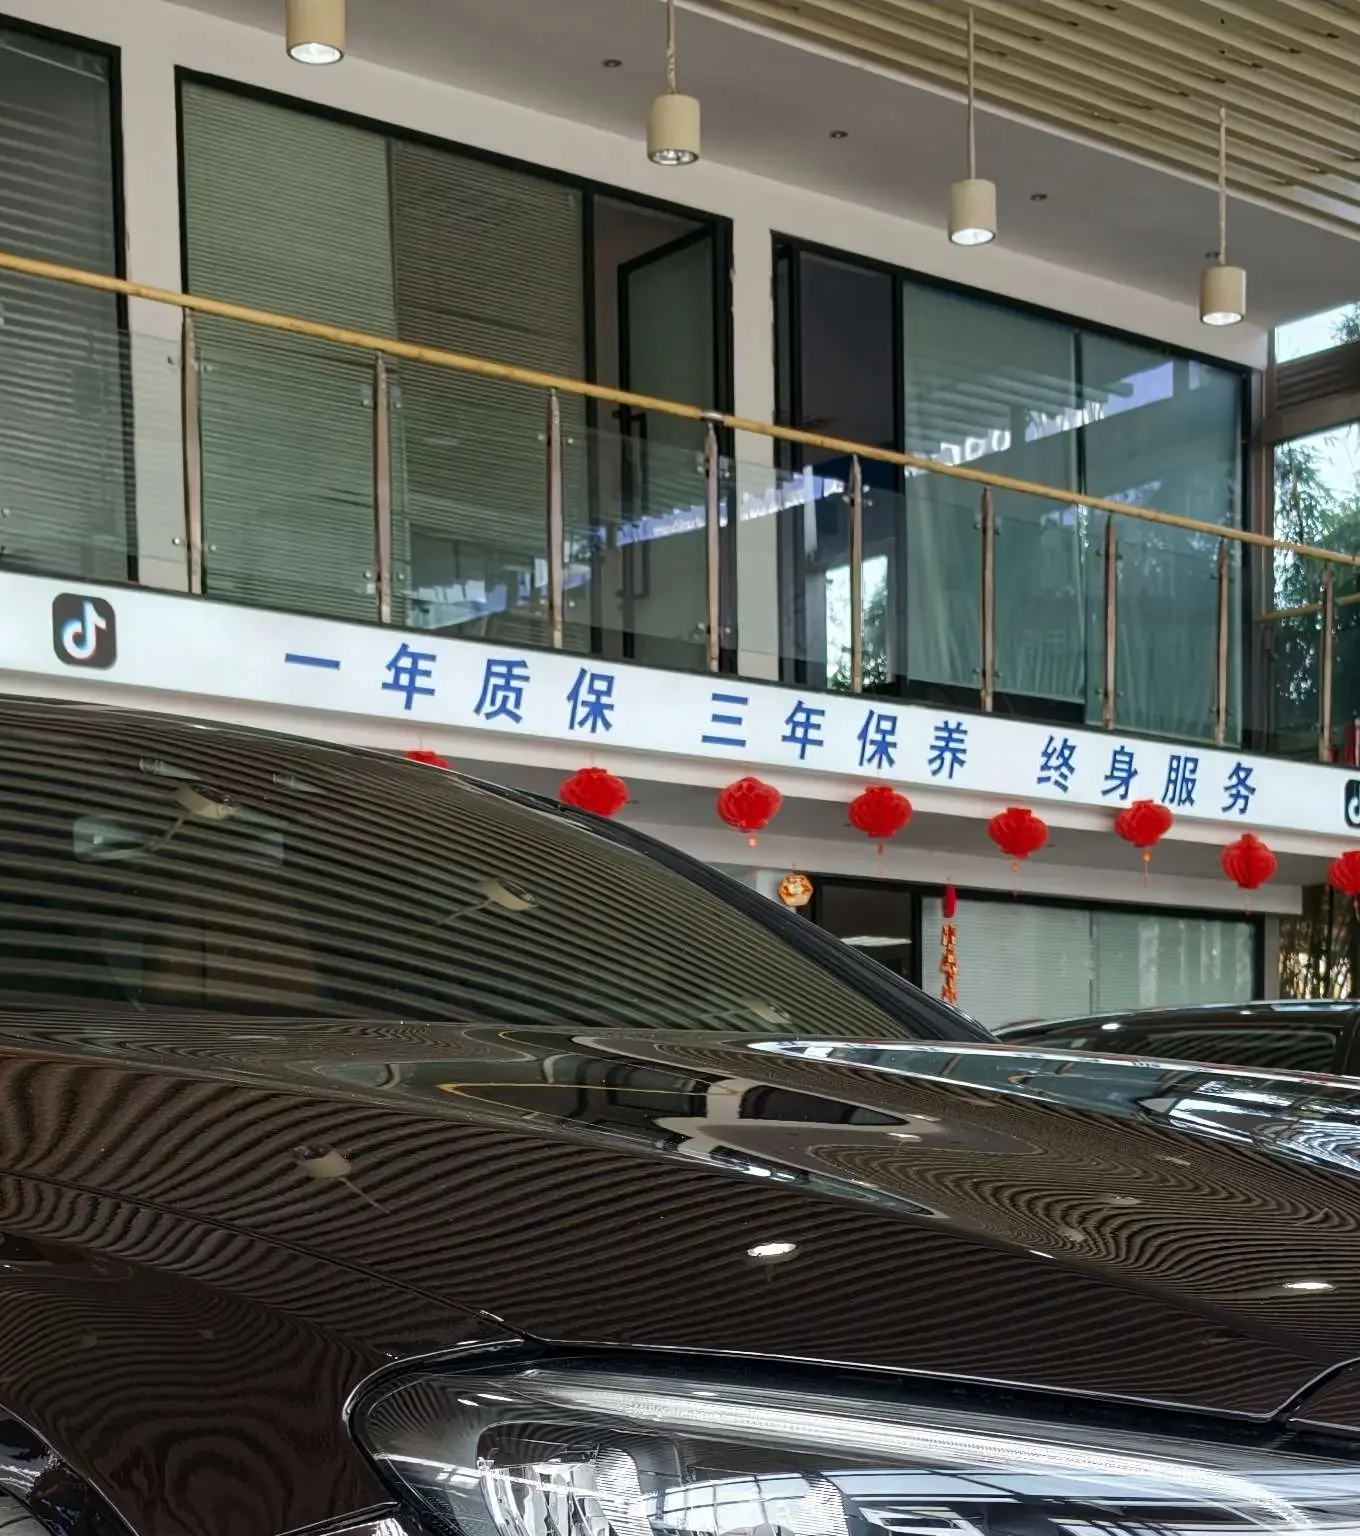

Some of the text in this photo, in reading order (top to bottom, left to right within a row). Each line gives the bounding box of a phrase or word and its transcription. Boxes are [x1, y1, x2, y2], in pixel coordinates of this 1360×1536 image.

[285, 641, 1262, 814] 一年质保 三年保养 终身服务
